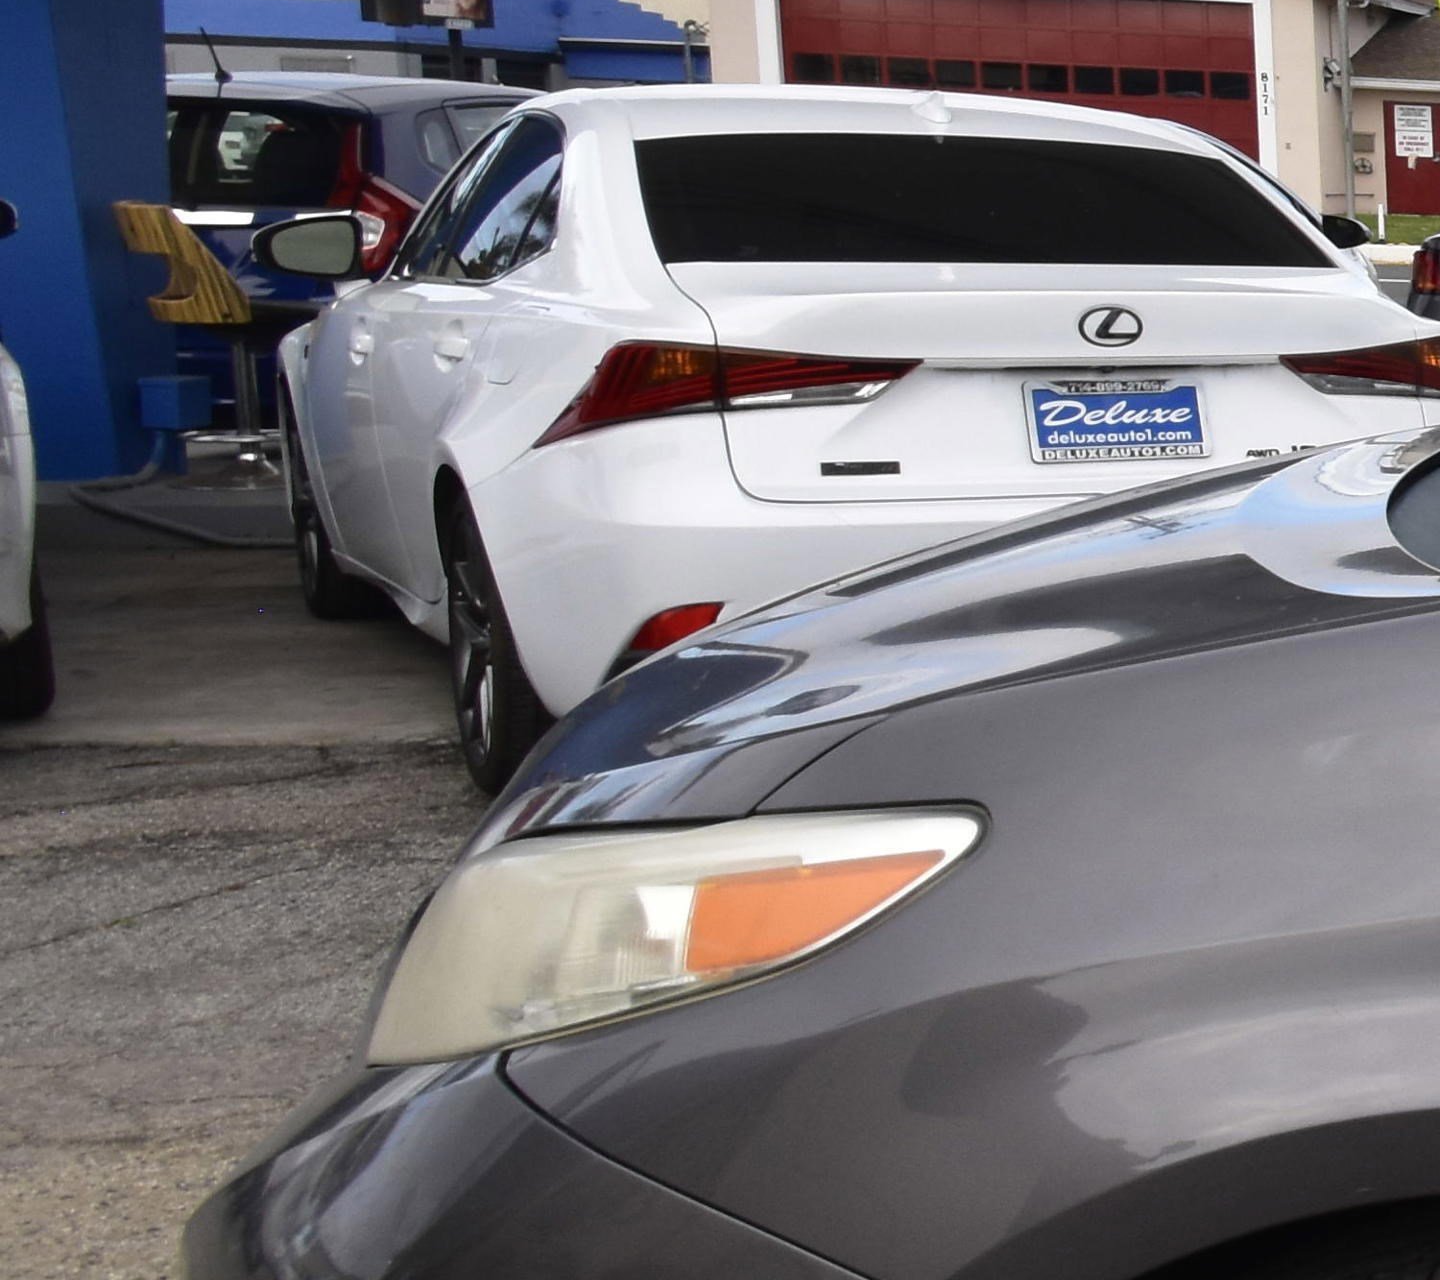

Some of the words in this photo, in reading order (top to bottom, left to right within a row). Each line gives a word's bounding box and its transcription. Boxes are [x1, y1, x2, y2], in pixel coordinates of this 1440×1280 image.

[1260, 72, 1269, 116] 8171
[1039, 400, 1193, 427] Deluxe
[1048, 429, 1192, 444] deluxeauto1.com
[1044, 445, 1201, 460] DELUXEAUTO1.COM
